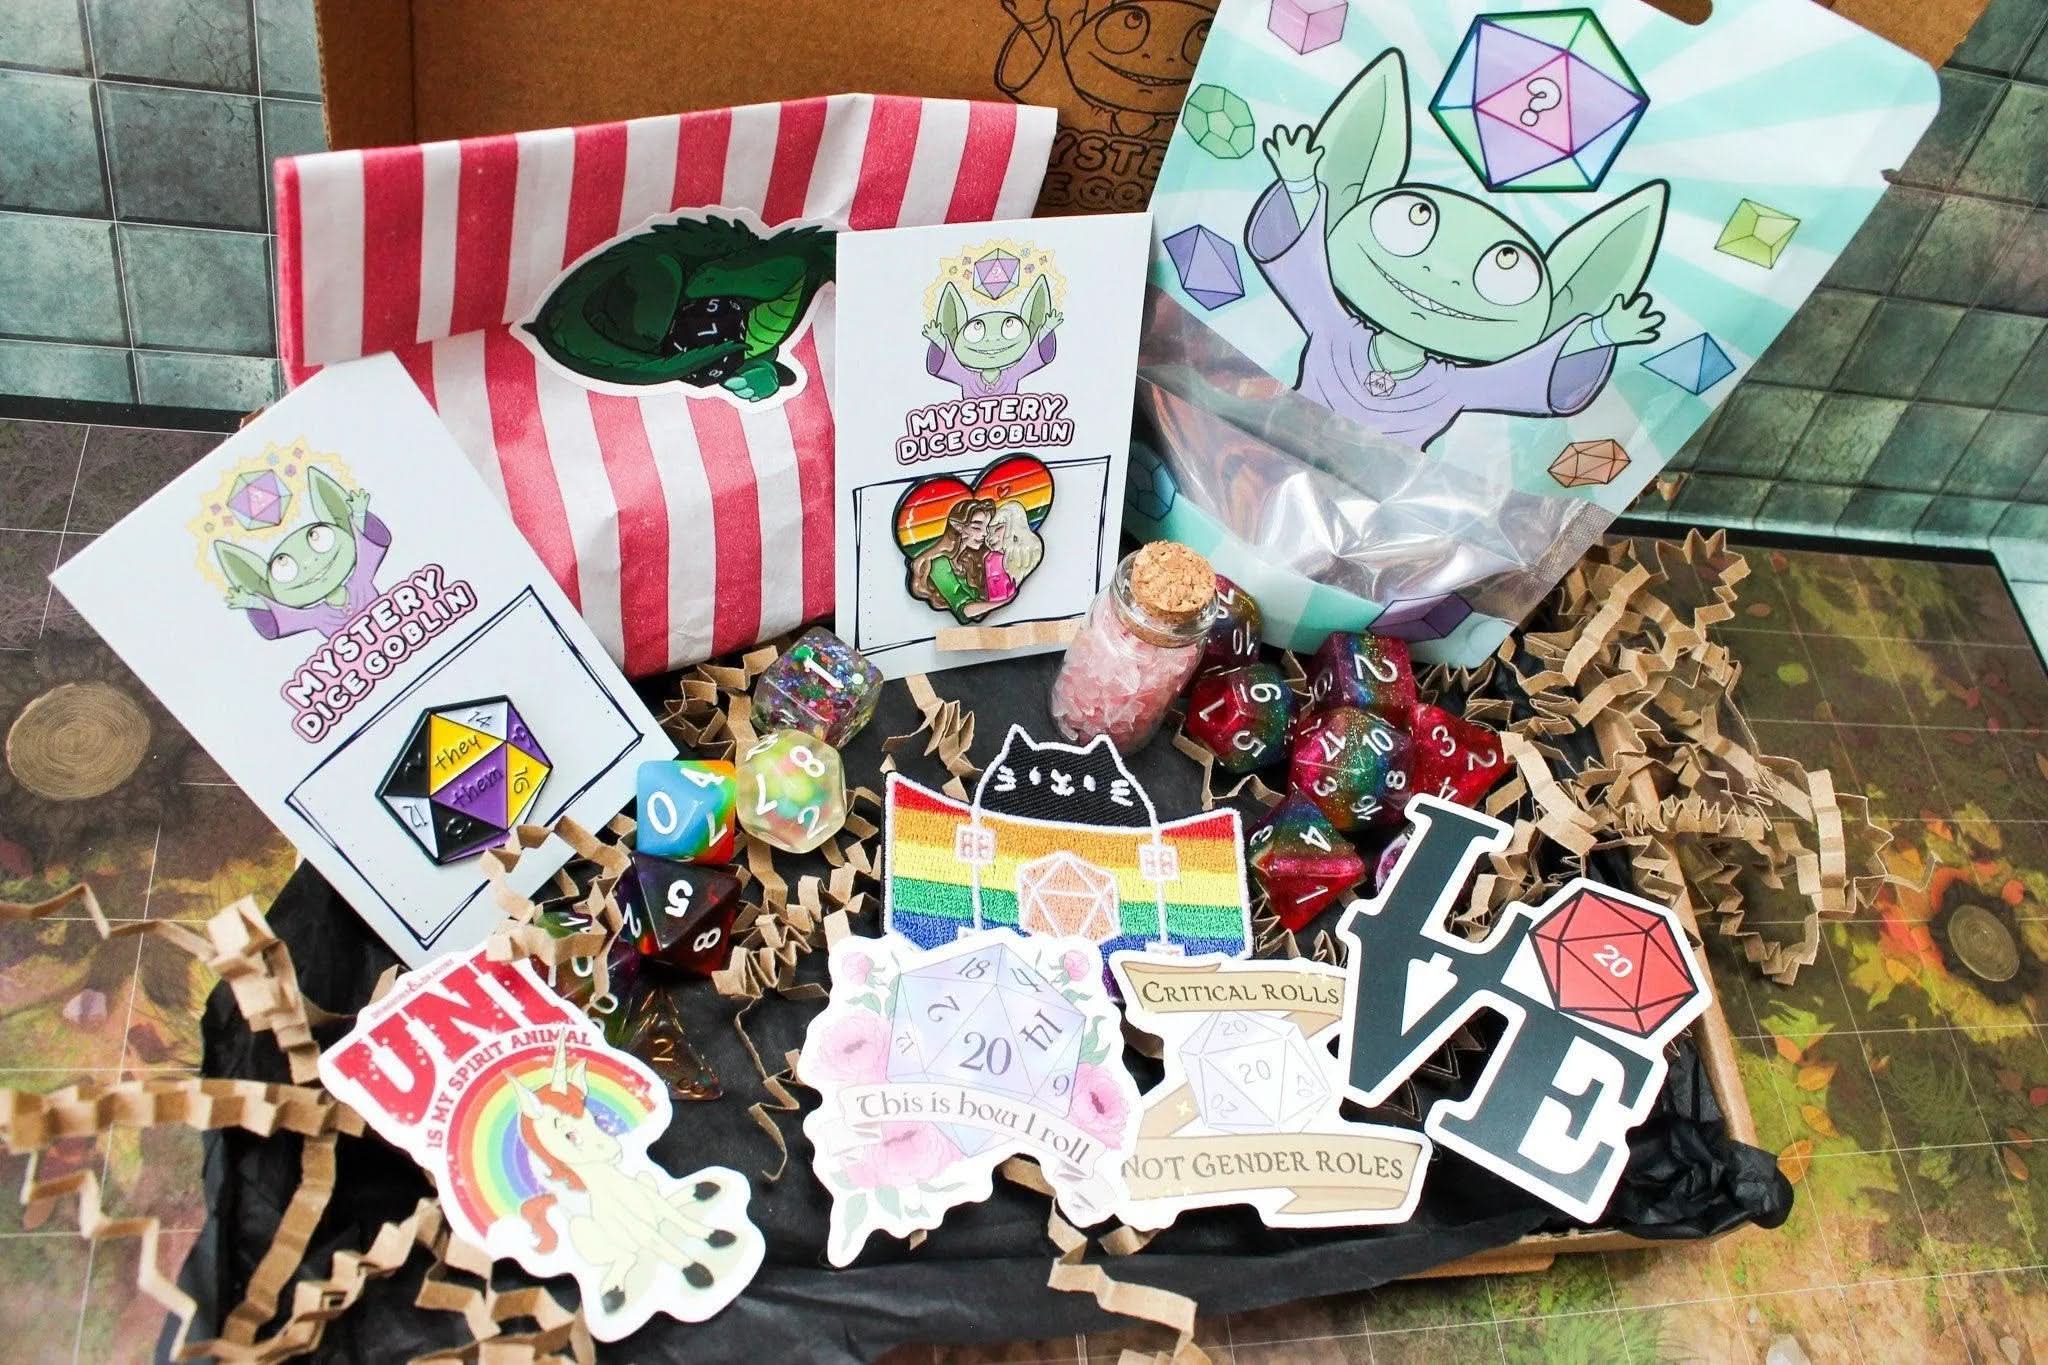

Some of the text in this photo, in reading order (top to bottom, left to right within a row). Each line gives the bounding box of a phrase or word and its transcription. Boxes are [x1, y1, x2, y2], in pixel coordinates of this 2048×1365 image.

[909, 396, 1063, 438] MYSTERY
[898, 420, 1072, 461] DICE GOBLIN
[285, 568, 440, 708] MYSTERY
[297, 584, 472, 738] DICE GOBLIN
[1354, 653, 1398, 683] 2
[434, 734, 483, 771] they
[1231, 729, 1267, 758] 5
[1362, 728, 1394, 756] 10
[1431, 725, 1456, 758] 3
[790, 745, 826, 778] 8
[1467, 750, 1497, 771] 2
[451, 766, 504, 807] them
[1312, 776, 1338, 797] 3
[1385, 770, 1405, 790] 8
[647, 791, 678, 835] 0
[797, 805, 830, 840] 2
[1299, 825, 1332, 852] 4
[664, 879, 694, 918] 5
[692, 927, 722, 953] 8
[956, 957, 991, 980] 18
[1592, 944, 1633, 979] 20
[1262, 983, 1340, 1005] ROLLS
[332, 949, 579, 1125] UNI
[1019, 1008, 1064, 1052] 14
[1219, 1018, 1249, 1036] 20
[652, 1037, 675, 1062] 2
[959, 1031, 1013, 1076] 20
[1238, 1058, 1272, 1085] 20
[426, 1028, 593, 1149] IS MY SPIRIT ANIMAL
[856, 1090, 924, 1118] This
[931, 1093, 950, 1115] is
[1024, 1112, 1038, 1137] I
[1040, 1129, 1091, 1165] roll
[1121, 1153, 1185, 1181] NOT
[1317, 1150, 1404, 1180] ROLES
